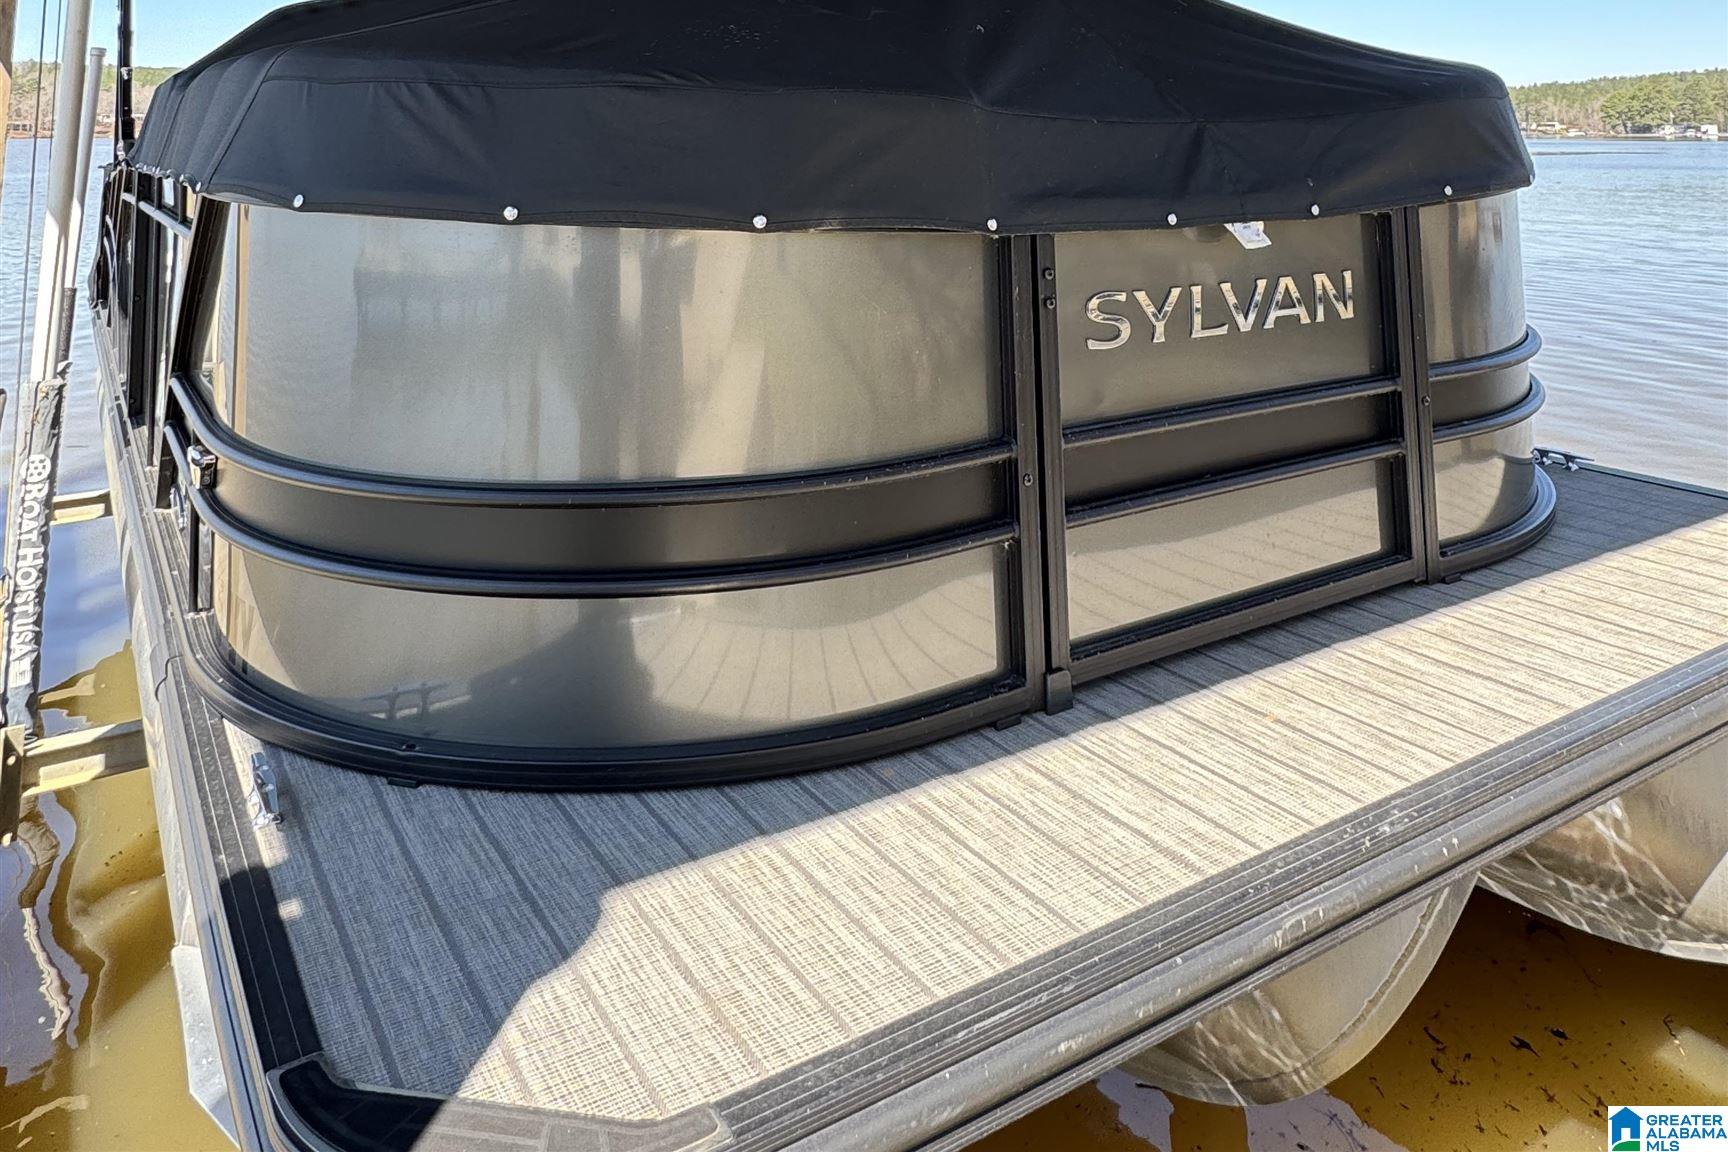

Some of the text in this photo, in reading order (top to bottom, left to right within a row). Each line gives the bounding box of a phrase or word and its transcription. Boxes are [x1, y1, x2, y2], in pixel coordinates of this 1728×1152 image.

[1085, 270, 1354, 350] SYLVAN
[13, 546, 45, 614] HOIST
[10, 615, 41, 661] USA
